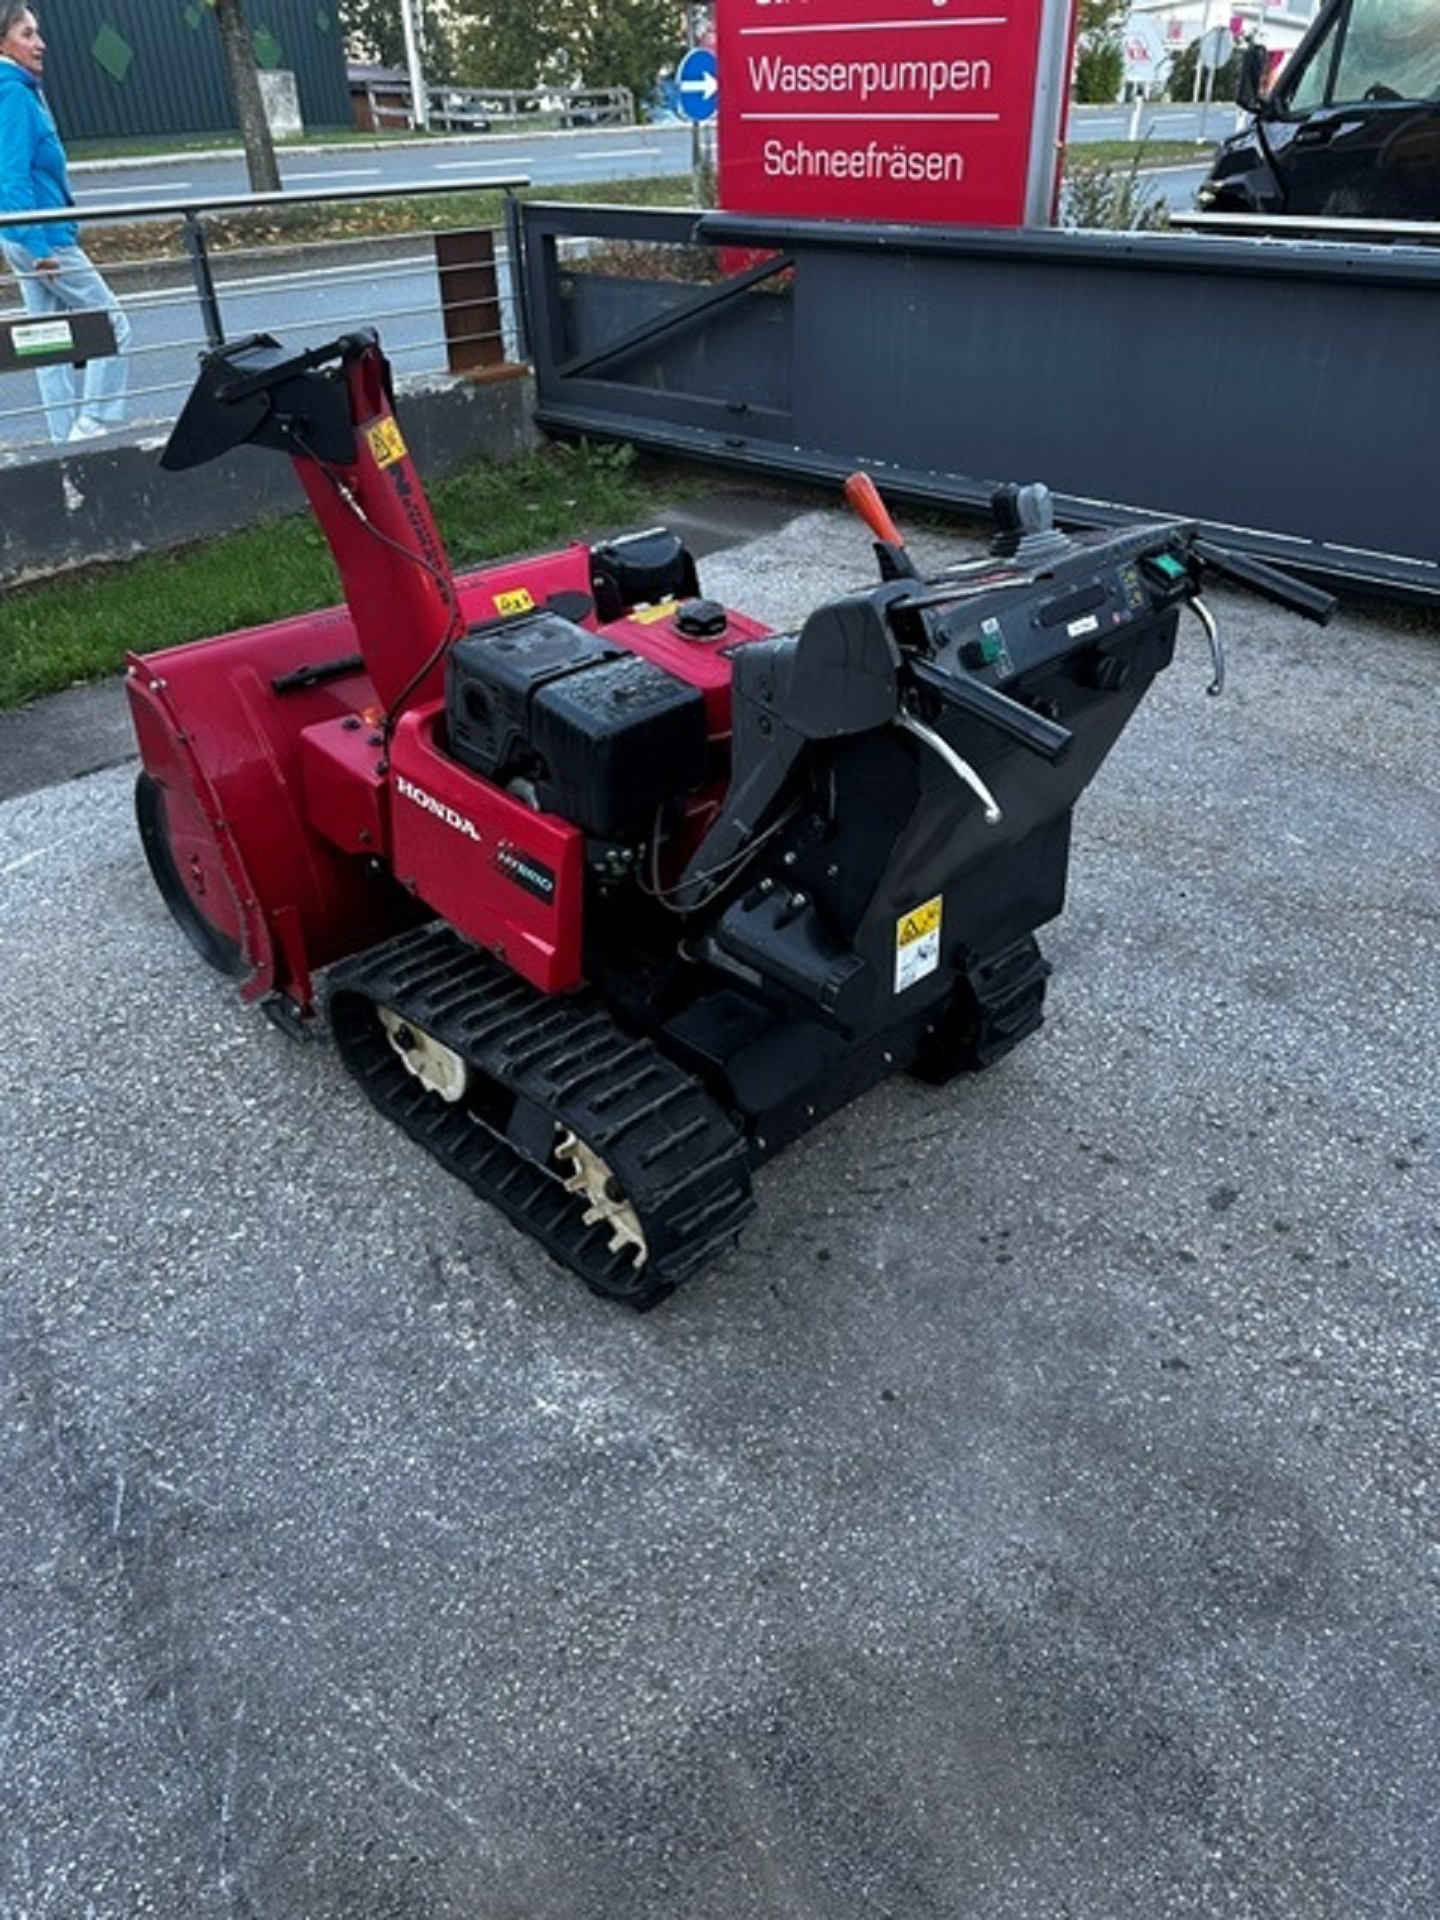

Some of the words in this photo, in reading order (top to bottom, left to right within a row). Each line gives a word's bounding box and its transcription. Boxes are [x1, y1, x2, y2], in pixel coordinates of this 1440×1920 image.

[748, 55, 991, 100] Wasserpumpen
[763, 138, 964, 181] Schneefräsen
[396, 776, 482, 842] HONDA
